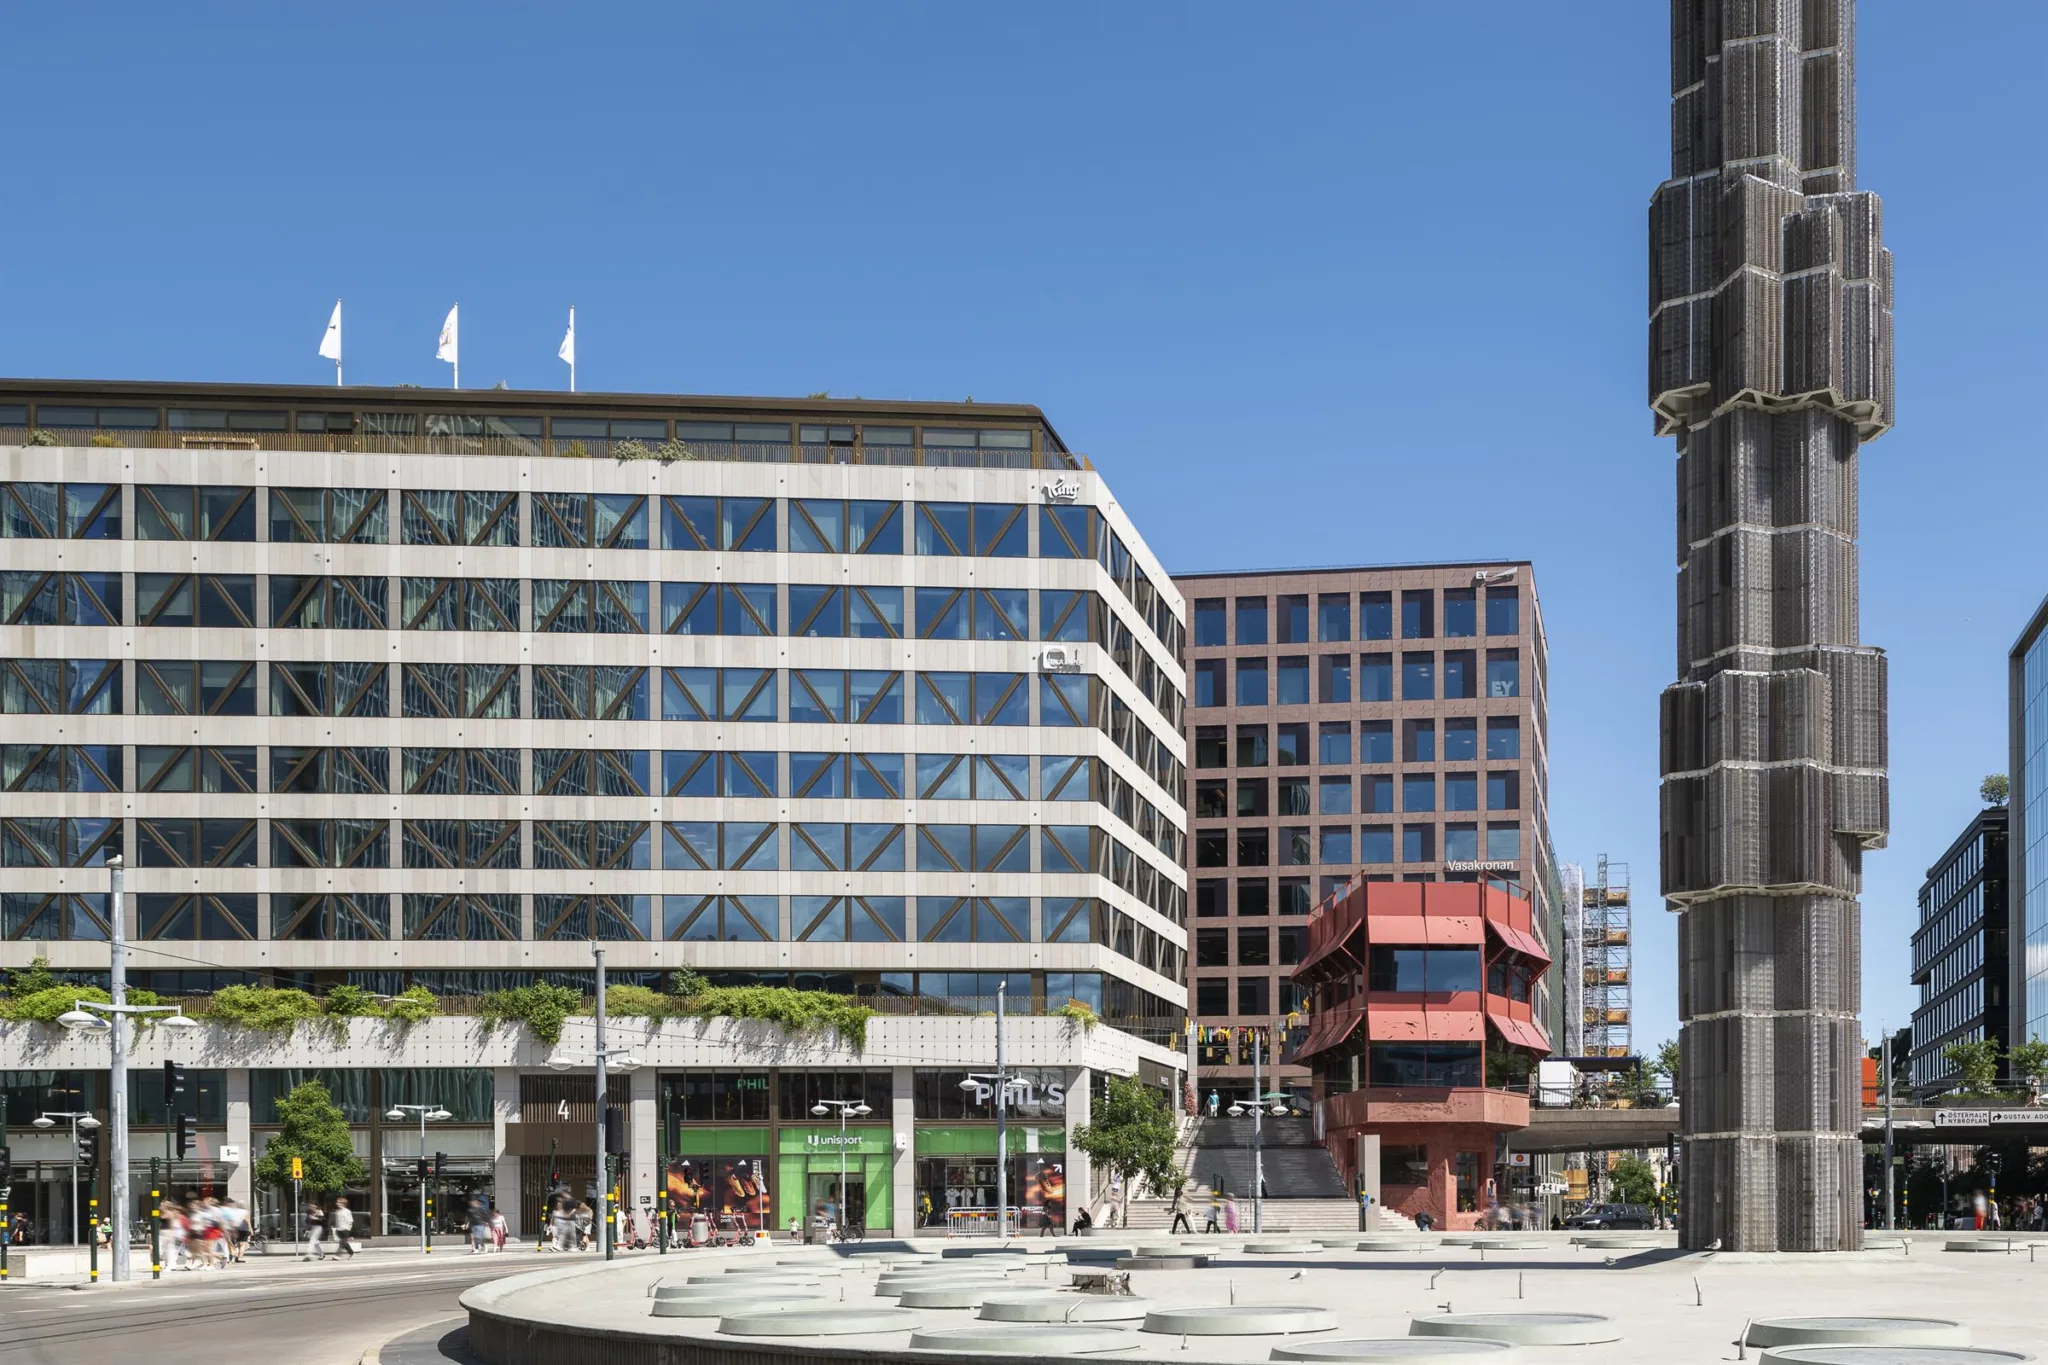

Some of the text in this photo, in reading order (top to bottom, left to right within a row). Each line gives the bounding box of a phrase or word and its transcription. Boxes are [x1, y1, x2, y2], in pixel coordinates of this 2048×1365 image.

[1044, 475, 1080, 499] King
[1475, 571, 1488, 579] EY
[1491, 680, 1514, 697] EY
[1447, 859, 1514, 871] Vasakronan
[557, 1099, 570, 1120] 4
[820, 1134, 863, 1146] unisport
